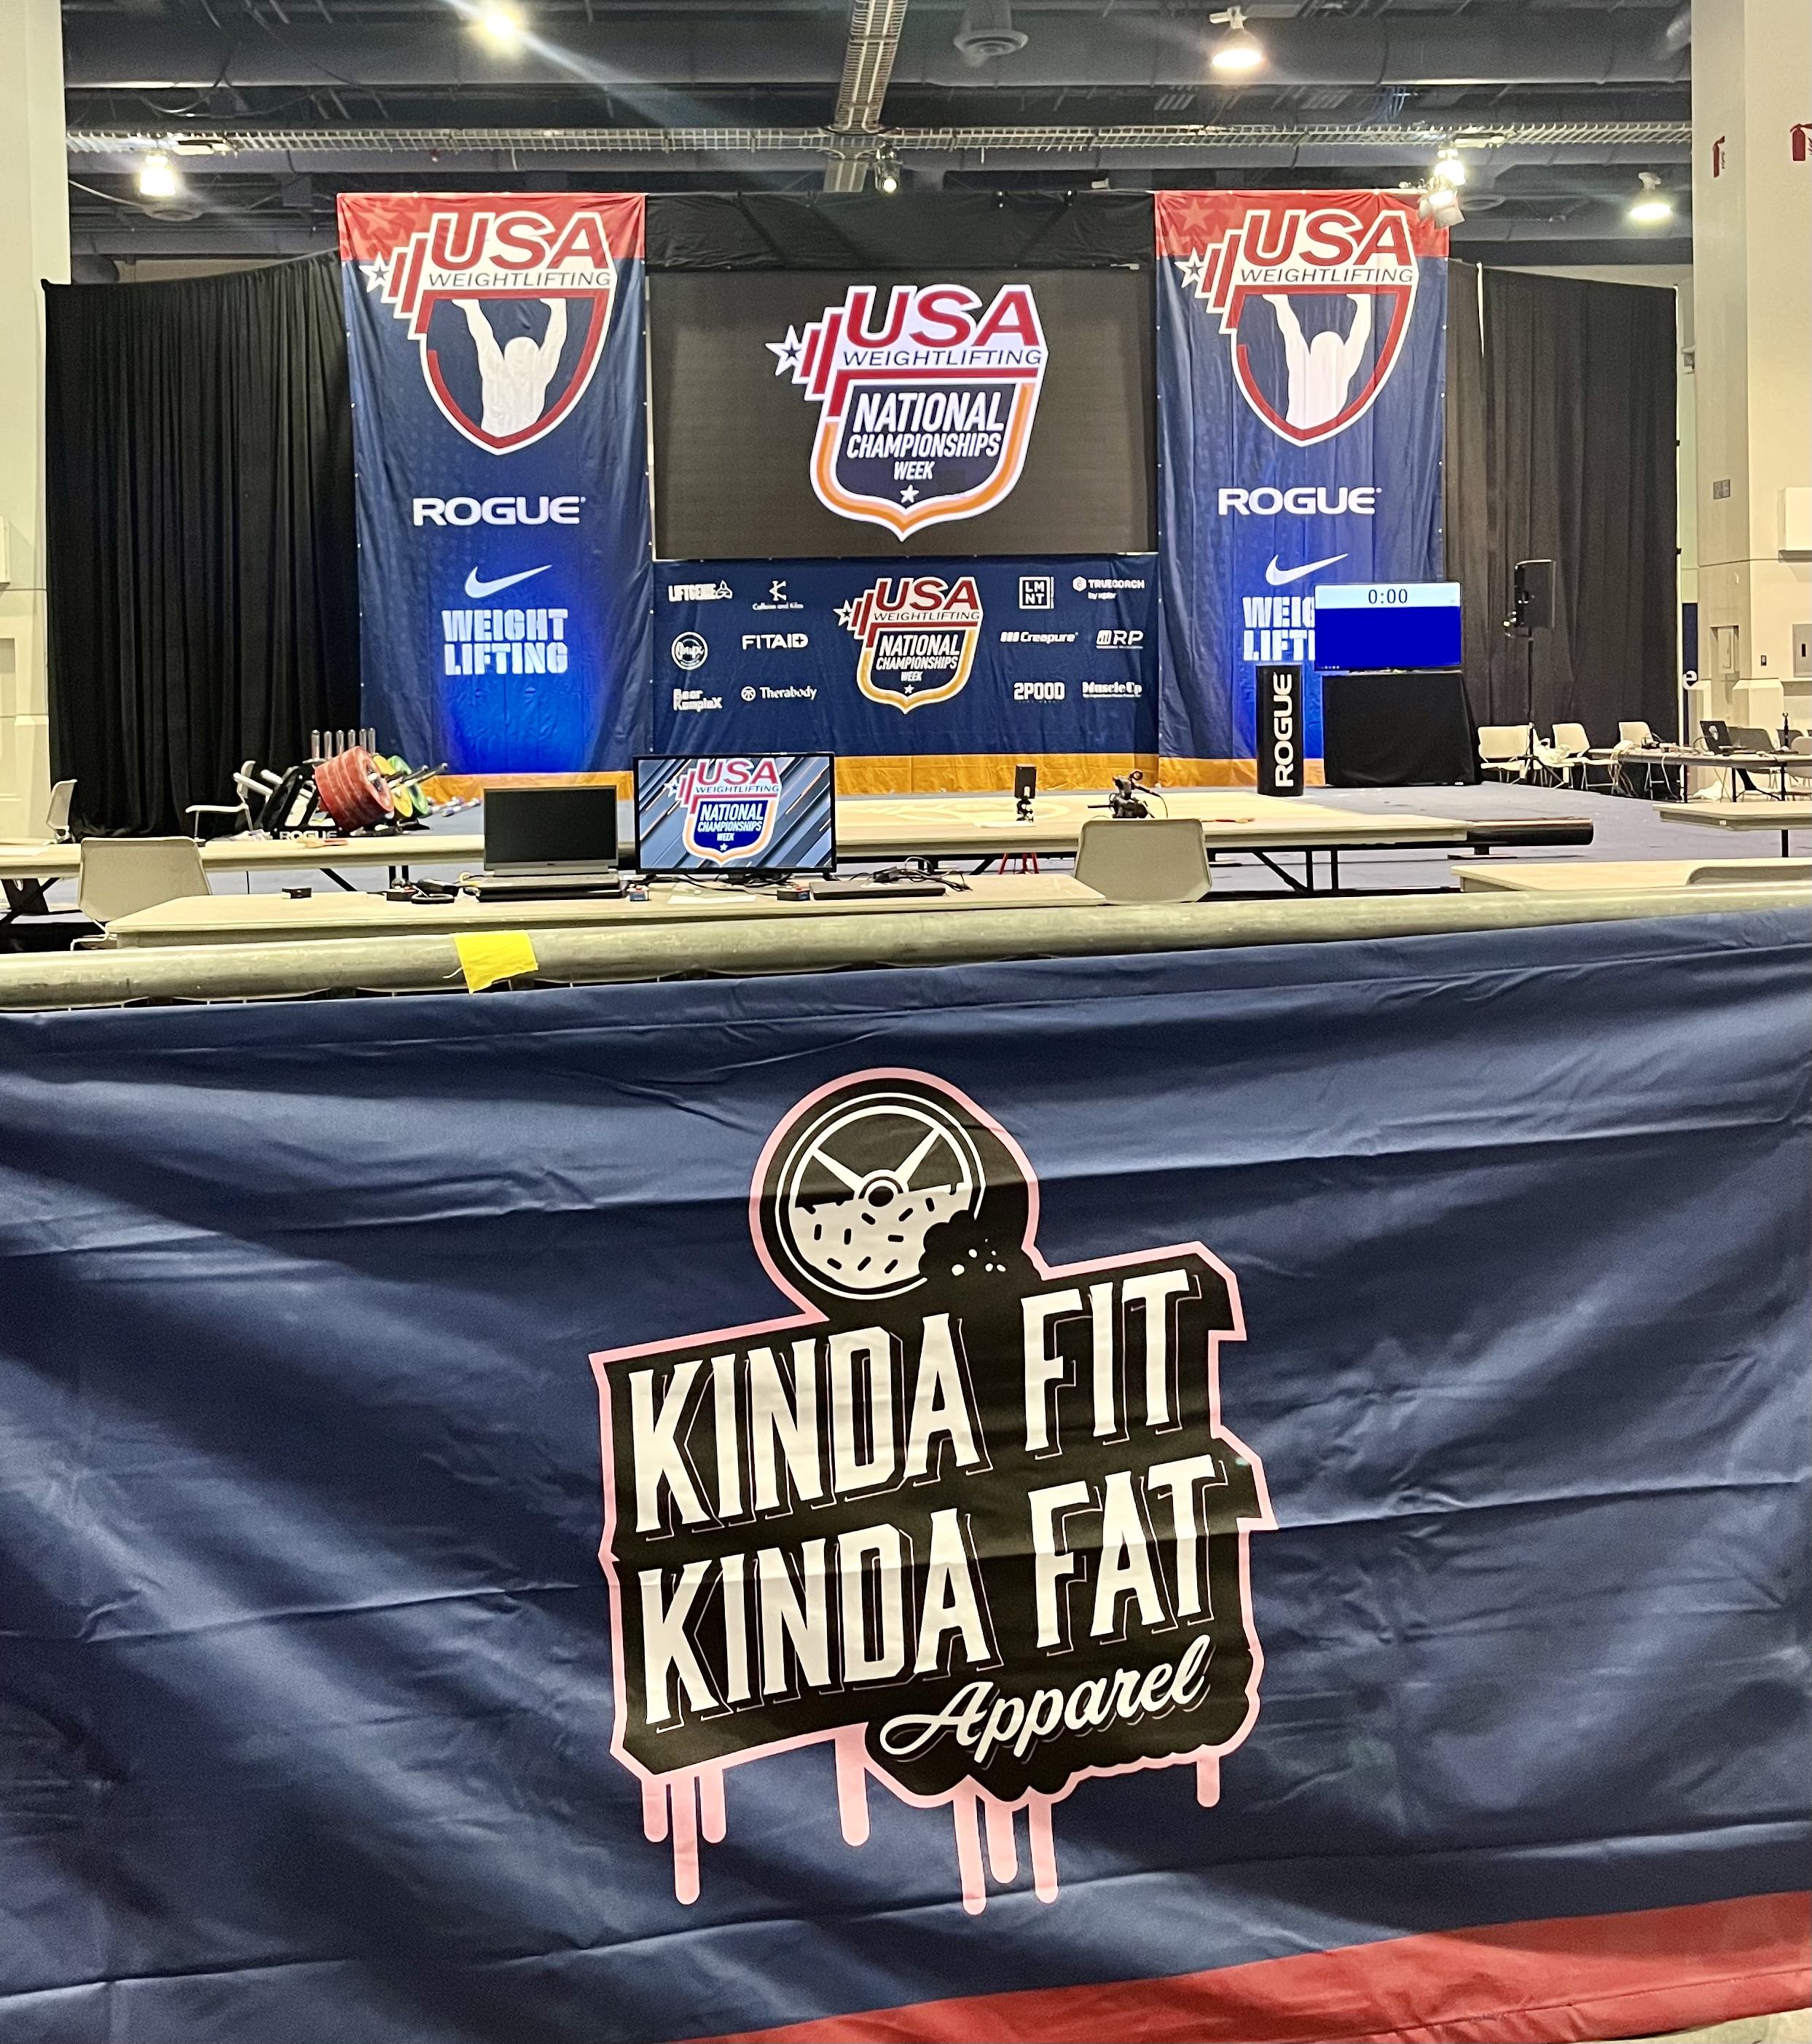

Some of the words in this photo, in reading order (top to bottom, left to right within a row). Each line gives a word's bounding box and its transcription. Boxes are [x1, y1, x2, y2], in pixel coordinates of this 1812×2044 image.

[431, 216, 608, 271] USA
[1243, 214, 1413, 267] USA
[428, 272, 612, 287] WEIGHTLIFTING
[1241, 267, 1413, 283] WEIGHTLIFTING
[847, 290, 1040, 348] USA
[843, 349, 1043, 367] WEIGHTLIFTING
[852, 391, 1005, 433] NATIONAL
[846, 433, 1002, 459] CHAMPIONSHIPS
[893, 461, 936, 481] WEEK
[876, 579, 980, 612] USA
[1368, 588, 1408, 604] 0:00
[874, 611, 981, 621] WEIGHTLIFTING
[1242, 595, 1316, 628] WEIG
[442, 608, 569, 642] WEIGHT
[742, 633, 809, 650] FITAID
[879, 634, 960, 657] NATIONAL
[1243, 629, 1316, 662] LIFTI
[444, 642, 568, 676] LIFTING
[875, 657, 960, 670] CHAMPIONSHIPS
[900, 670, 924, 682] WEEK
[759, 685, 817, 700] Therabody
[1013, 681, 1065, 700] 2POOD
[1273, 673, 1294, 788] ROGUE
[696, 760, 779, 786] USA
[695, 785, 780, 794] WEIGHTLIFTING
[699, 802, 764, 821] NATIONAL
[279, 830, 338, 840] ROGUE
[697, 821, 763, 833] CHAMPIONSHIPS
[716, 832, 735, 842] WEEK
[627, 1312, 985, 1536] KINDA
[1021, 1268, 1198, 1454] FIT
[639, 1508, 997, 1727] KINDA
[1028, 1454, 1223, 1651] FAT
[879, 1635, 1210, 1765] Apparel
